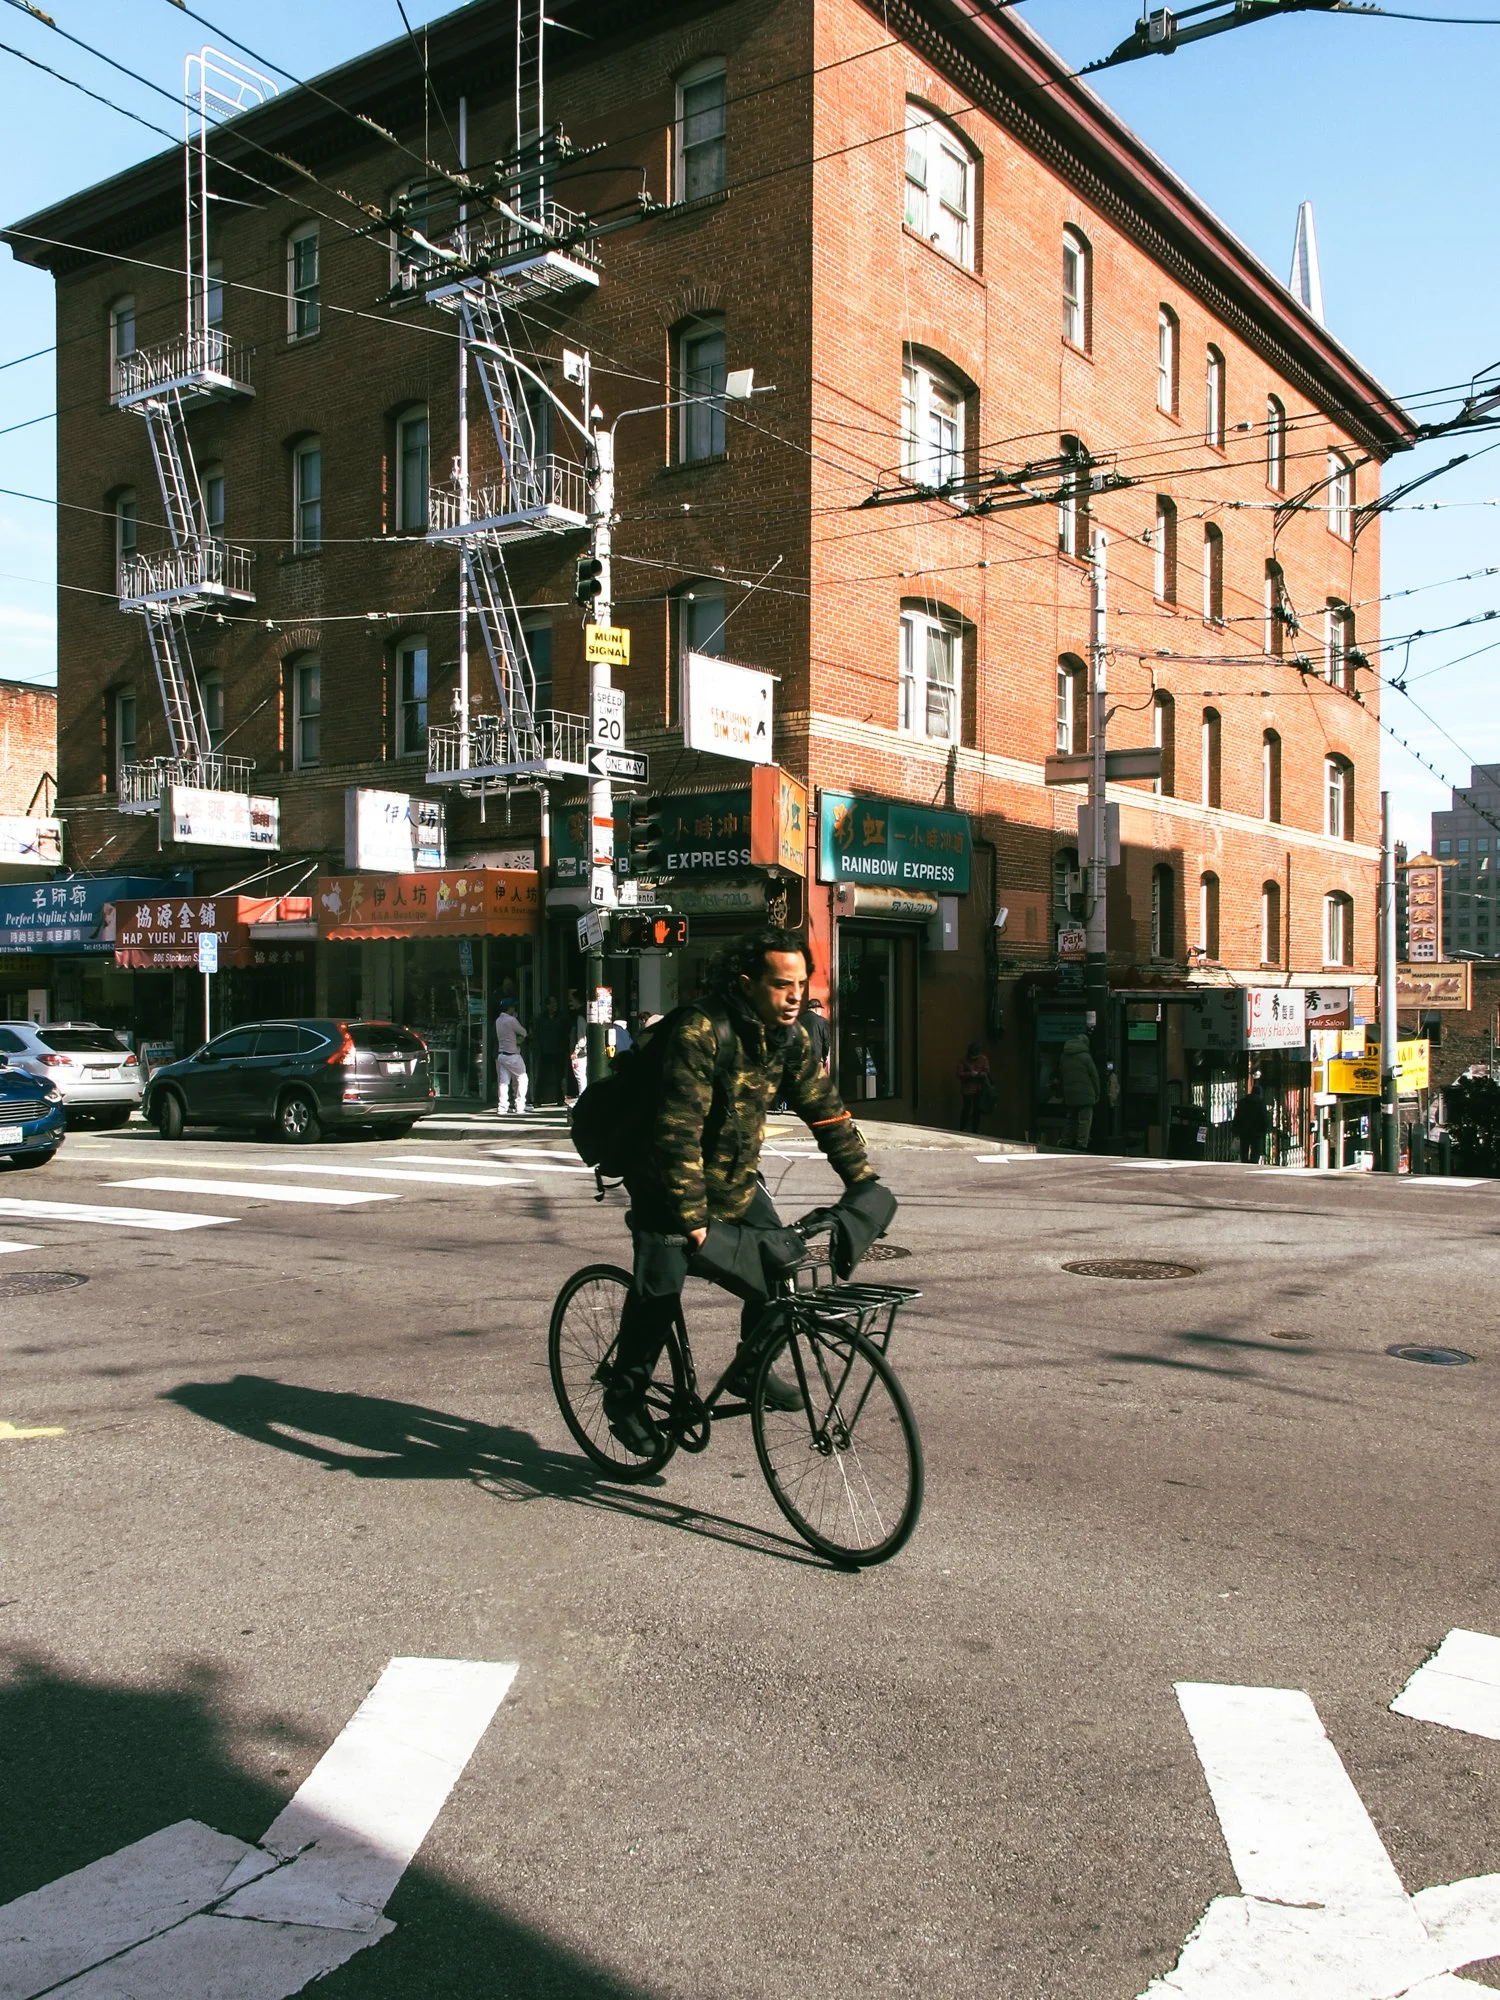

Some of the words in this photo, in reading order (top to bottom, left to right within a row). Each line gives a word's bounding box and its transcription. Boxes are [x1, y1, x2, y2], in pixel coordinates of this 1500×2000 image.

[594, 632, 624, 644] MUNI
[588, 645, 628, 659] SIGNAL
[597, 692, 623, 707] SPEED
[599, 705, 619, 717] LIMIT
[711, 706, 752, 728] FEATURING
[598, 717, 621, 741] 20
[713, 722, 729, 741] DIM
[732, 727, 751, 745] SUM
[605, 757, 623, 772] ONE
[625, 759, 644, 775] WAY
[201, 826, 227, 840] YUN
[230, 829, 274, 844] JEWELRY
[667, 849, 751, 870] EXPRESS
[841, 855, 898, 876] RAINBOW
[903, 862, 955, 882] EXPRESS
[374, 885, 427, 907] 伊人坊
[5, 911, 35, 928] Perfect
[36, 910, 68, 927] Styling
[69, 909, 93, 923] Salon
[135, 902, 217, 929] 協源金鋪
[122, 932, 143, 945] HAP
[147, 931, 176, 944] YUEN
[181, 931, 230, 945] JEWRY
[677, 920, 686, 942] 2
[1063, 932, 1084, 945] Park
[165, 953, 192, 963] Stockton
[1305, 990, 1322, 1011] 秀
[1273, 1022, 1286, 1037] Hair
[1286, 1022, 1302, 1037] Salon
[1308, 1019, 1324, 1027] Hair
[1324, 1019, 1345, 1027] Salon
[1368, 1046, 1379, 1057] D
